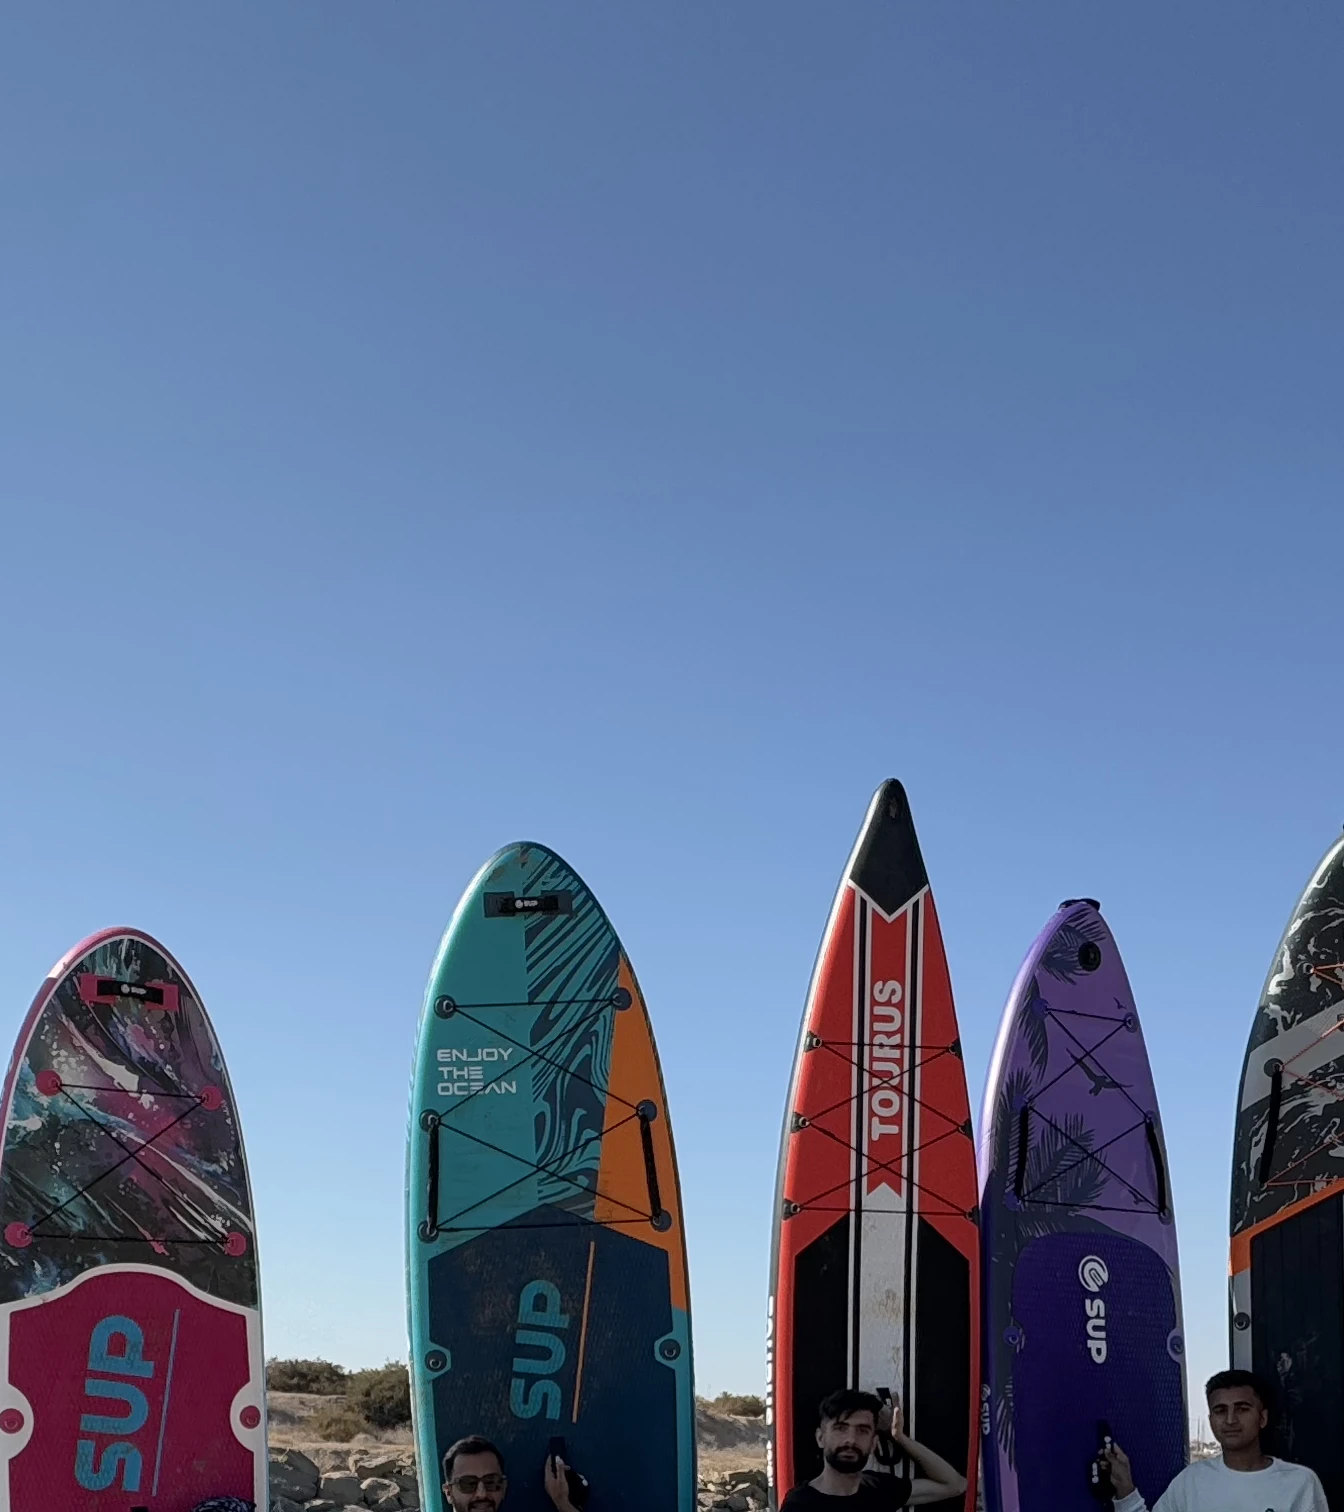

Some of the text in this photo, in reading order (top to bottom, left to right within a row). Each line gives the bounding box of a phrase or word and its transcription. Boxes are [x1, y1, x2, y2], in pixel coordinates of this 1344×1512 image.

[437, 1047, 513, 1062] ENJOY
[438, 1066, 483, 1080] THE
[871, 979, 903, 1141] TOURUS
[437, 1081, 516, 1096] OCEAN
[509, 1279, 570, 1420] SUP
[1084, 1298, 1108, 1365] SUP
[74, 1314, 155, 1492] SUP
